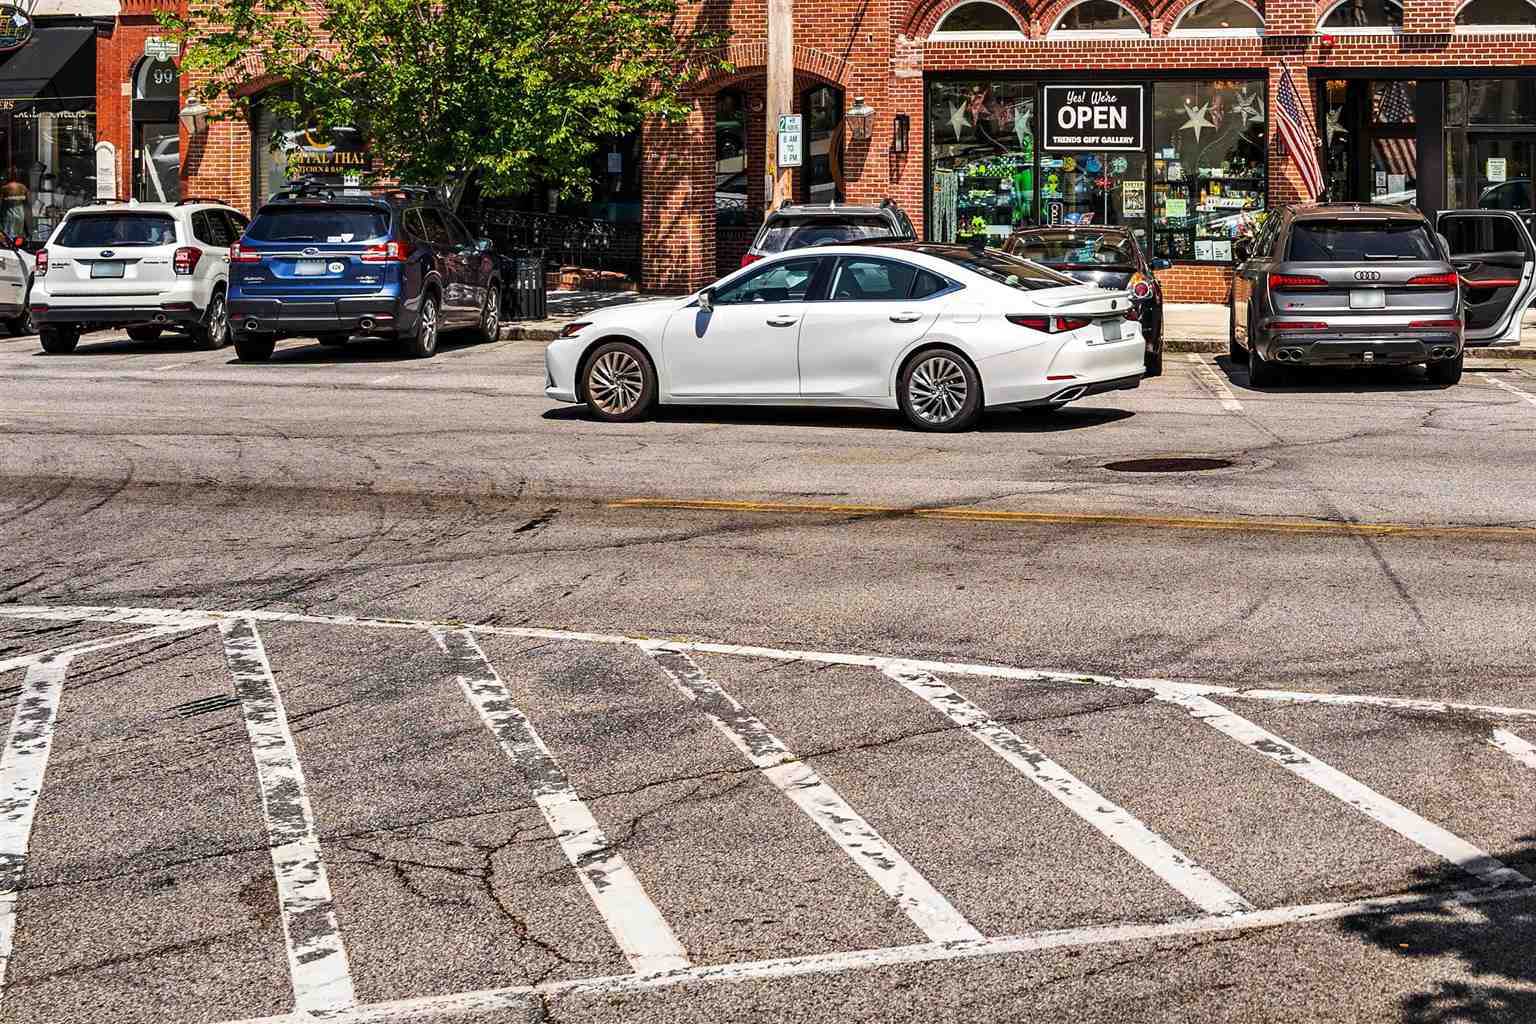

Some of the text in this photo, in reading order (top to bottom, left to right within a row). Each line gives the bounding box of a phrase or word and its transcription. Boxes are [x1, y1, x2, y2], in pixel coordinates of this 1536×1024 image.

[153, 69, 173, 84] 99
[1067, 90, 1117, 105] Yes! We're
[1058, 106, 1127, 129] OPEN
[1053, 136, 1134, 144] TRENDS GIFT GALLERY
